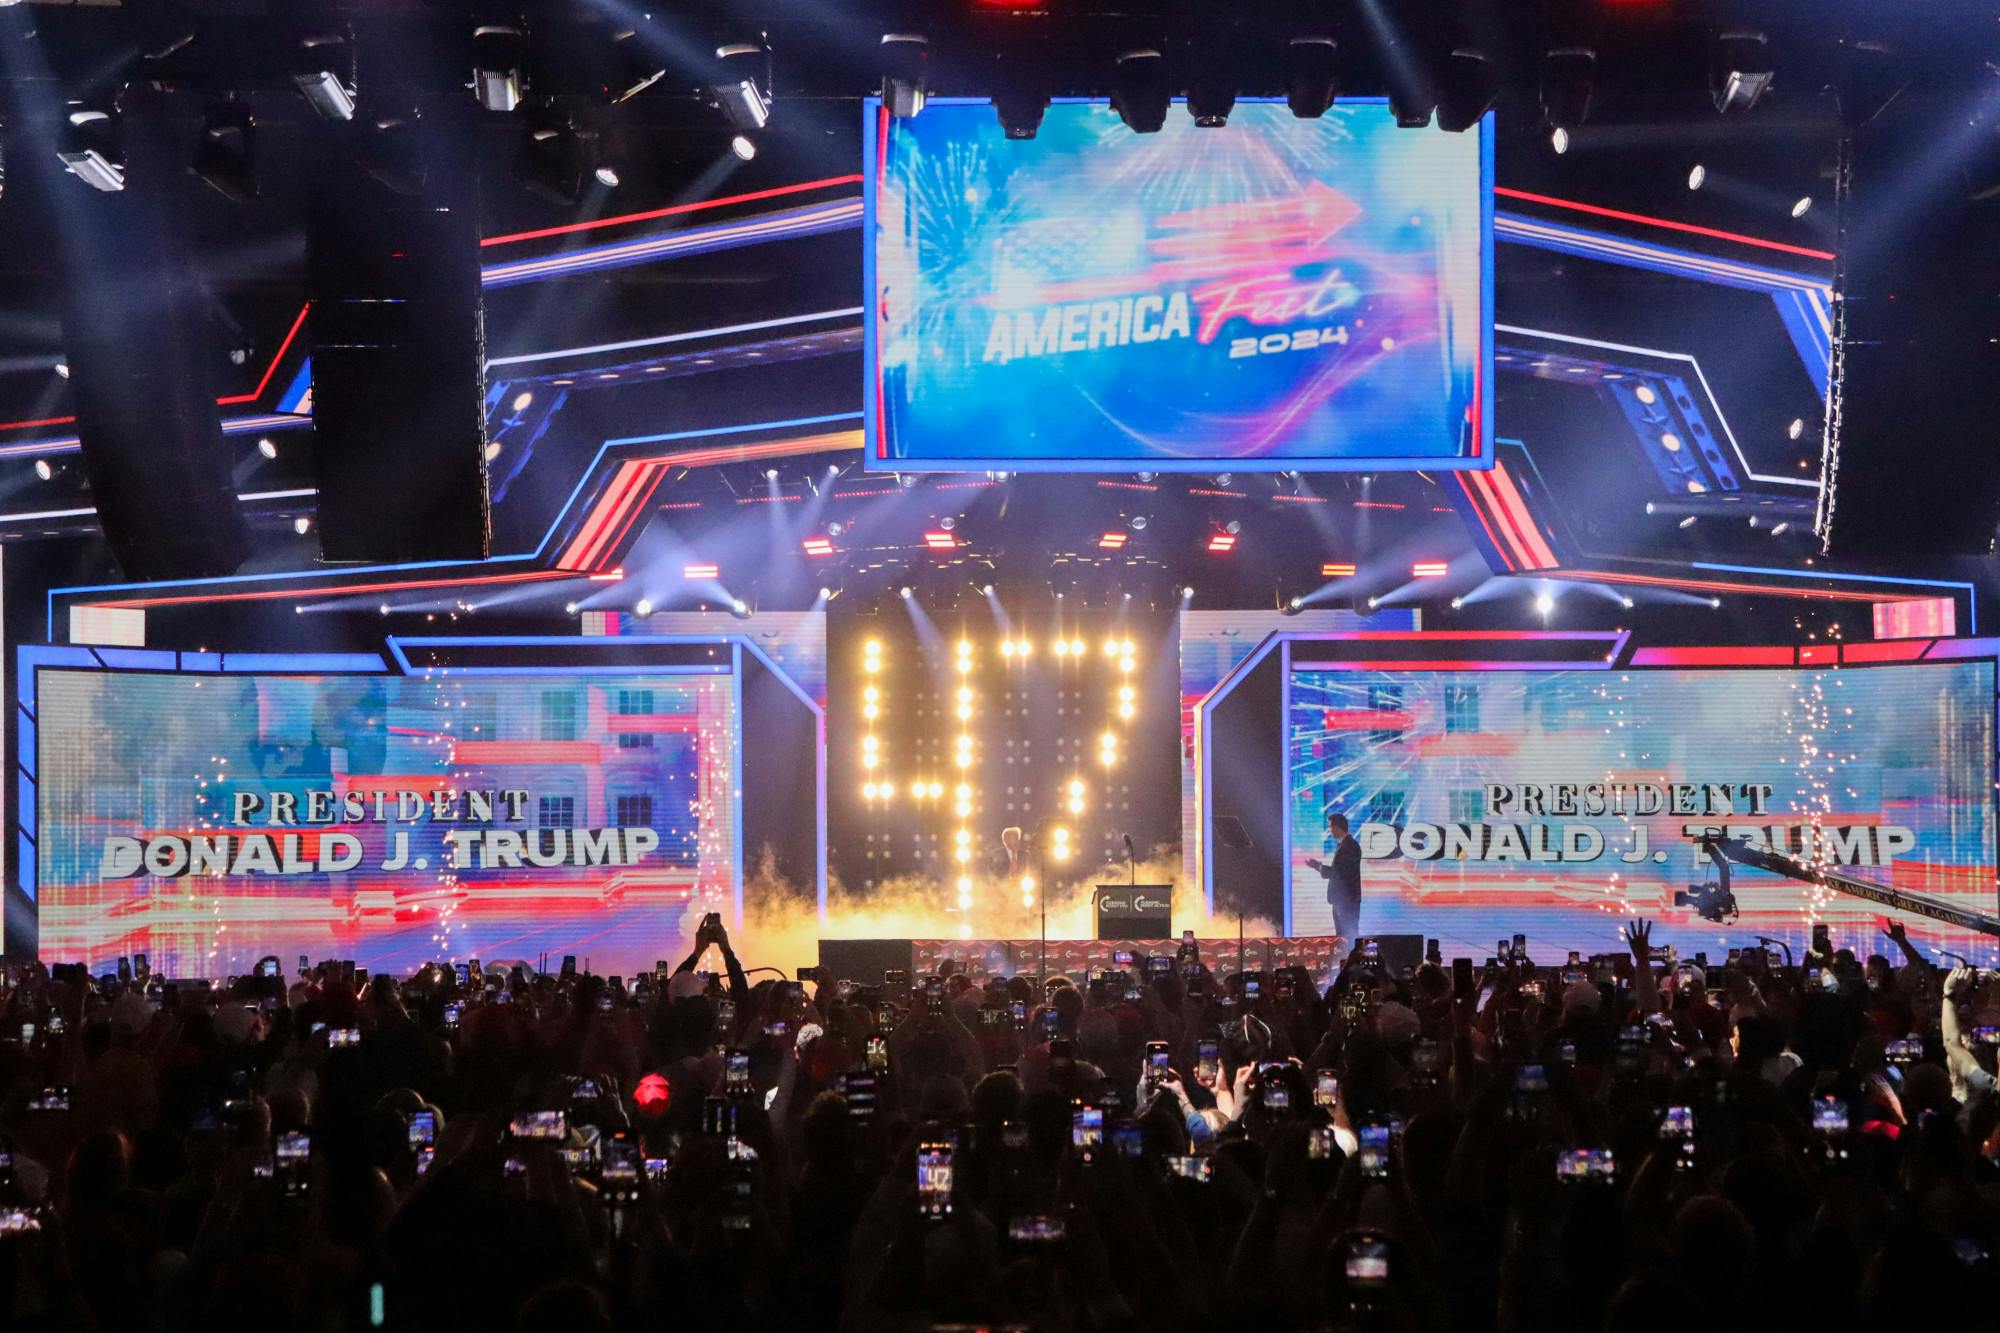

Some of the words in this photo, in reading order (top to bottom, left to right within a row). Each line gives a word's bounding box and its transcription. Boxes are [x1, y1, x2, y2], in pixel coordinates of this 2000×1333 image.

[982, 290, 1191, 362] AMERICA
[1198, 269, 1357, 343] Fest
[1229, 325, 1349, 359] 2024
[232, 790, 530, 825] PRESIDENT
[862, 637, 1138, 940] 47
[1485, 783, 1775, 816] PRESIDENT
[101, 832, 364, 879] DONALD
[380, 832, 428, 872] J.
[450, 826, 660, 869] TRUMP
[1360, 822, 1606, 862] DONALD
[1622, 823, 1667, 862] J.
